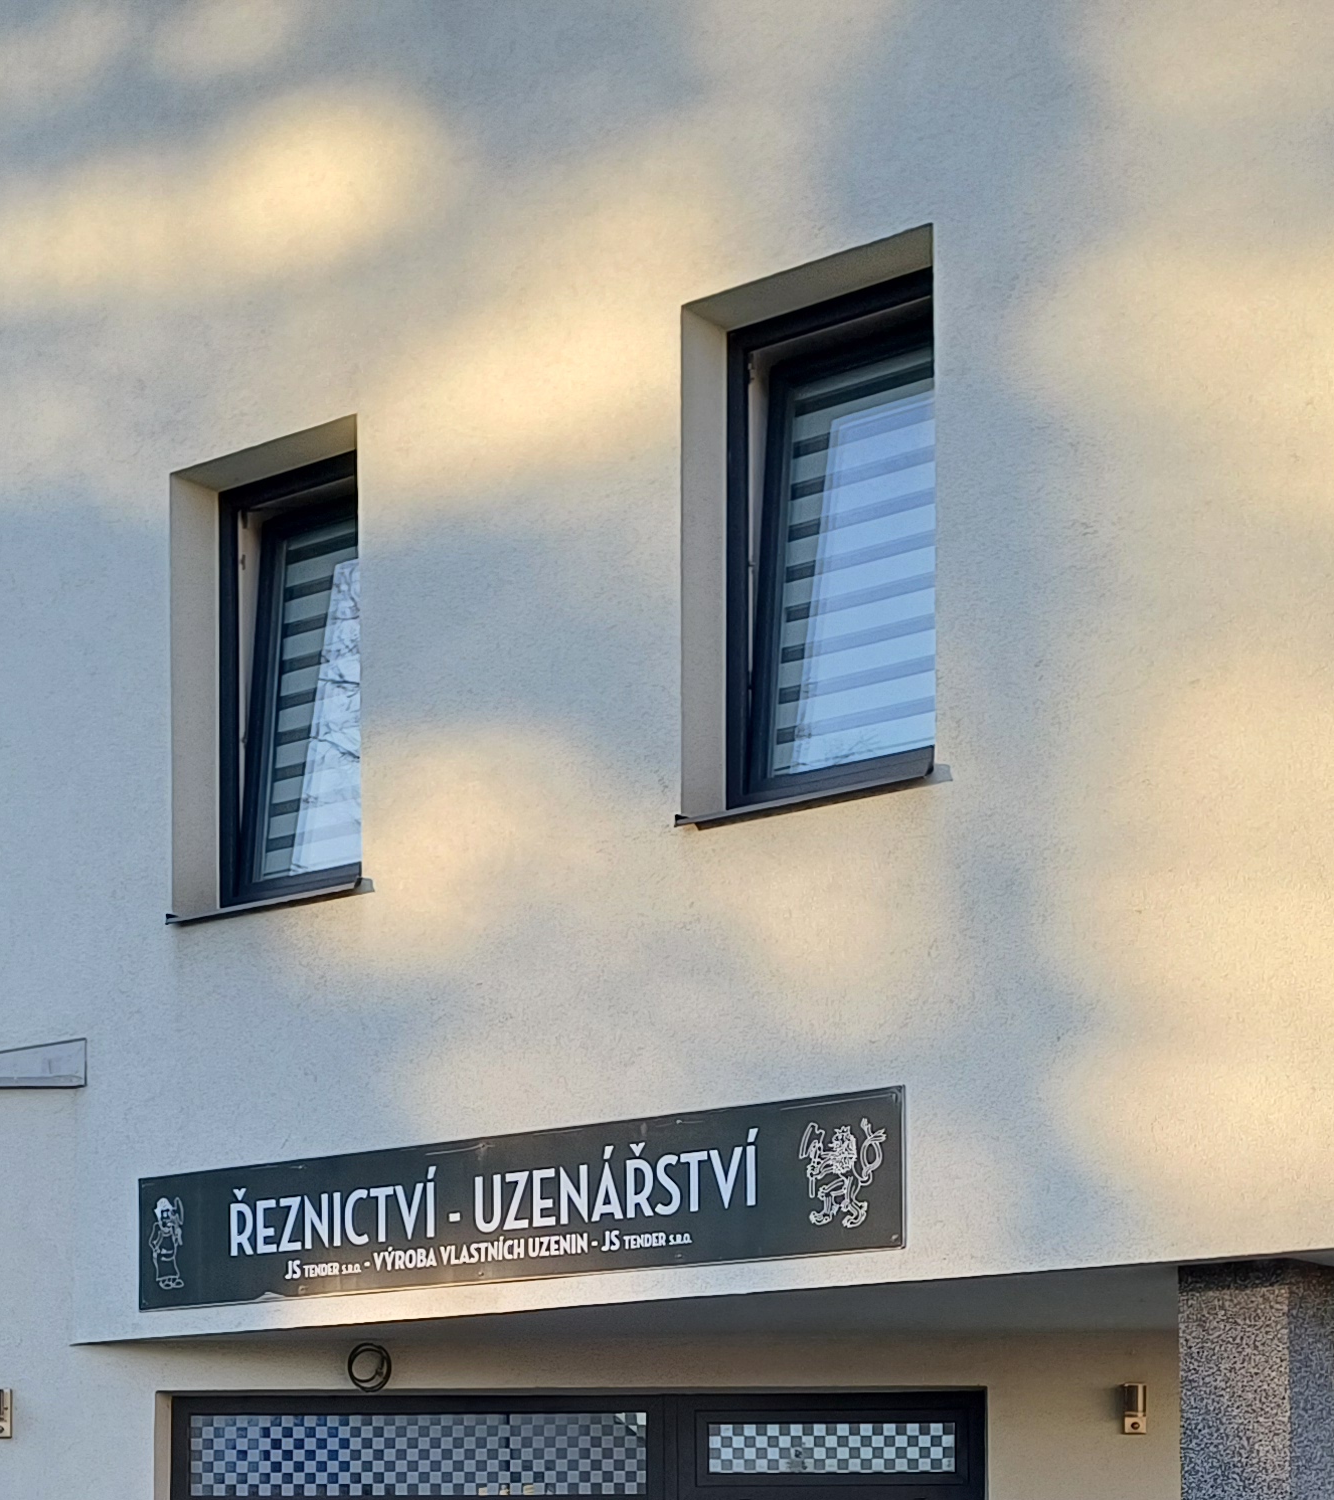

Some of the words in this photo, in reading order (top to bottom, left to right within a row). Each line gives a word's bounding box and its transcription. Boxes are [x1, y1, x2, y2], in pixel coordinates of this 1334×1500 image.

[230, 1166, 437, 1257] ŘEZNICTVÍ
[474, 1128, 759, 1233] UZENÁŘSTVÍ
[284, 1260, 301, 1280] JS
[303, 1262, 340, 1278] TENDER
[373, 1246, 438, 1273] VÝROBA
[439, 1236, 522, 1265] VLASTNÍCH
[528, 1232, 588, 1259] UZENIN
[601, 1230, 621, 1252] JS
[623, 1232, 666, 1249] TENDER
